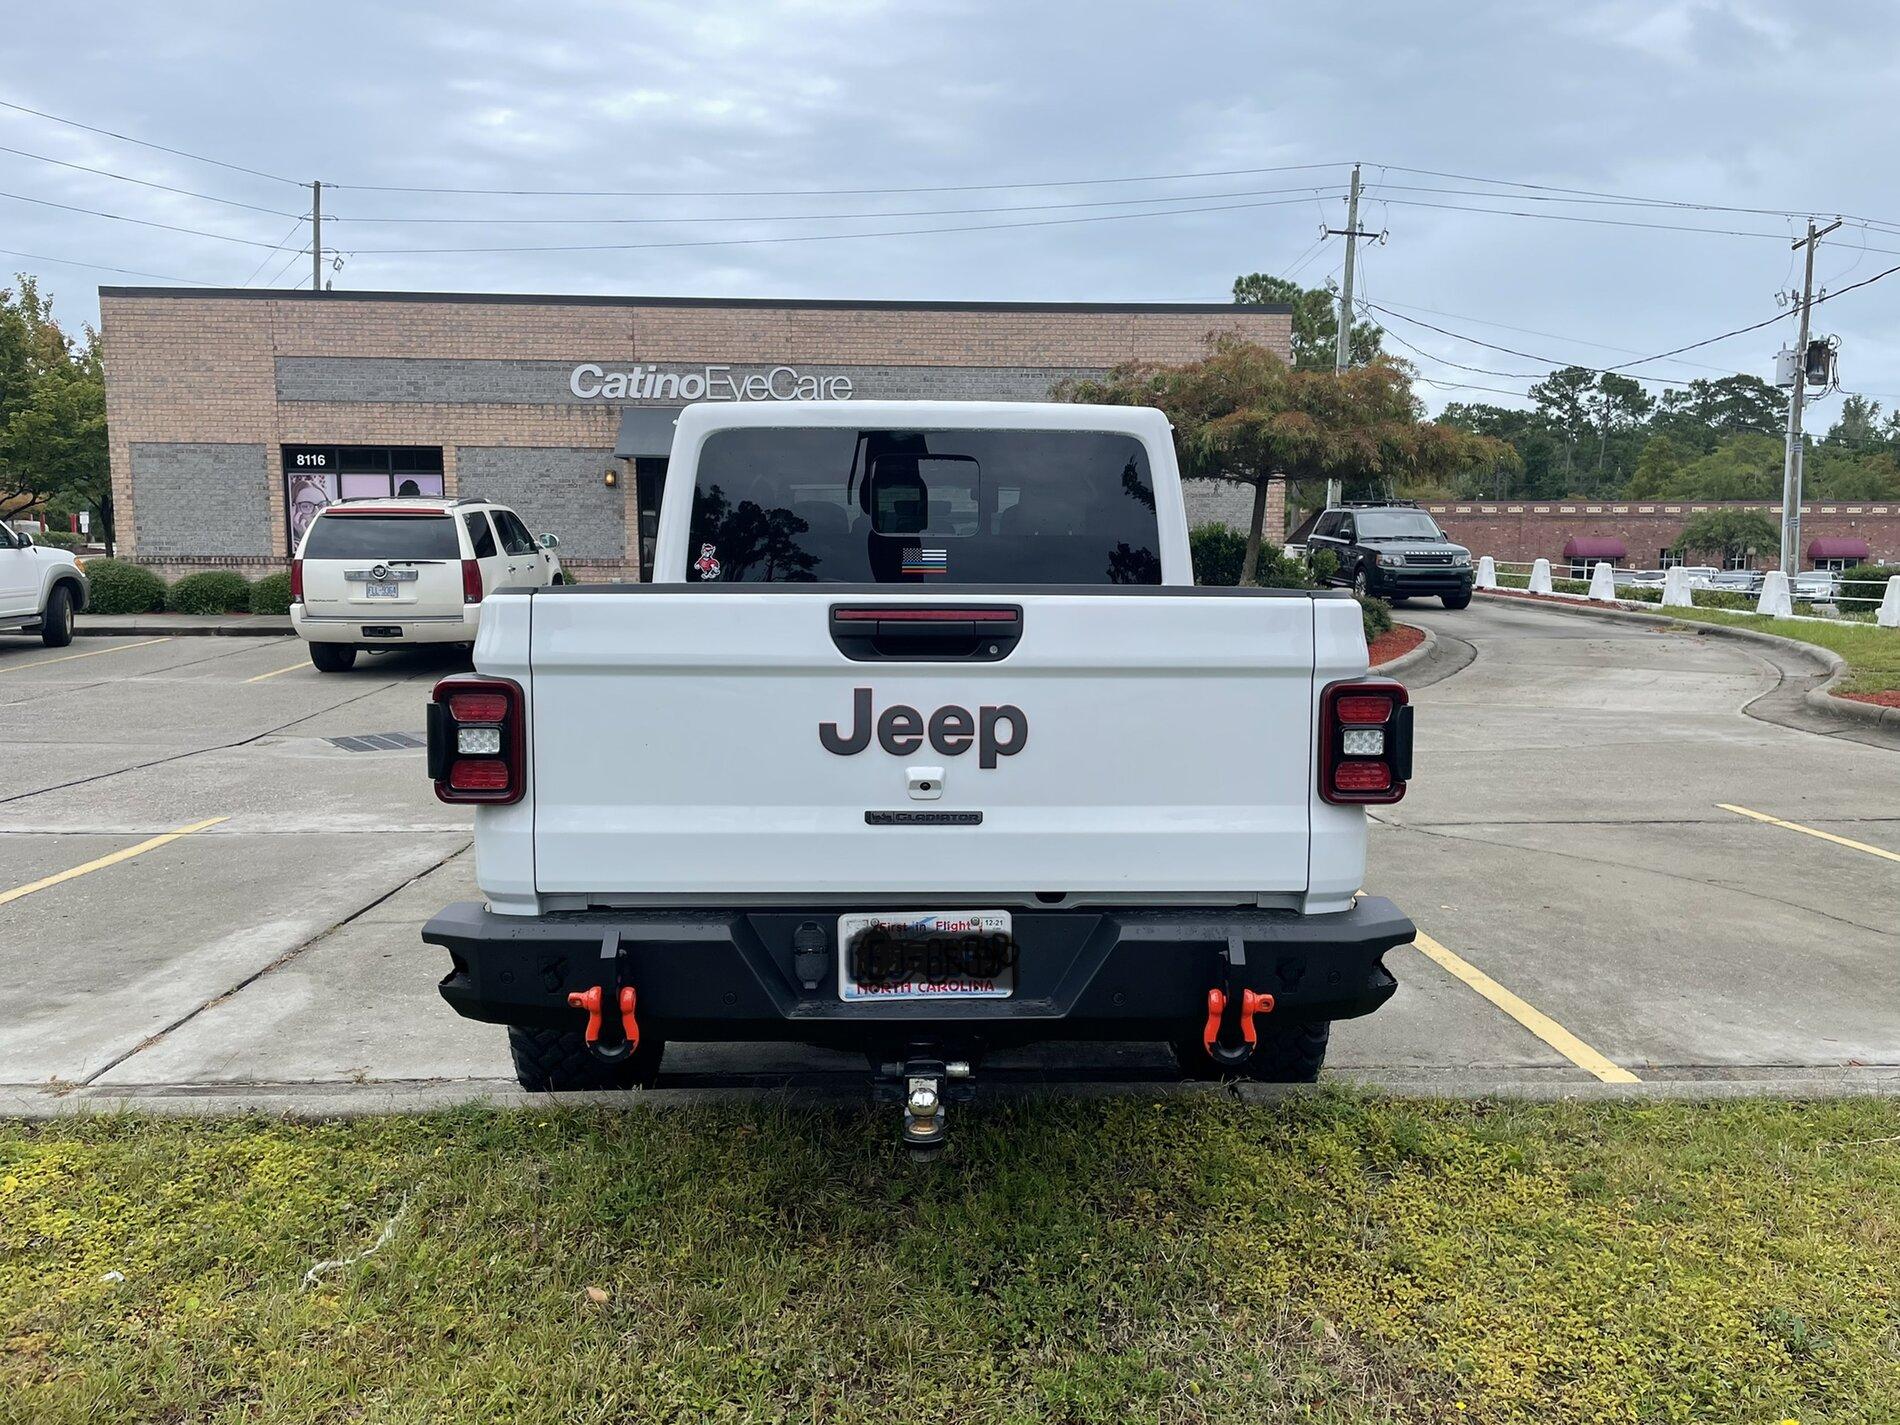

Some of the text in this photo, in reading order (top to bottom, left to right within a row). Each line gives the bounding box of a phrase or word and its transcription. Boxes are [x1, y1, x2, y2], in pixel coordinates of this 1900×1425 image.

[570, 363, 853, 401] CatinoEyeCare
[296, 454, 326, 466] 8116
[819, 687, 1028, 769] Jeep
[880, 920, 971, 933] First in Flight
[857, 980, 995, 995] NORTH CAROLINA
